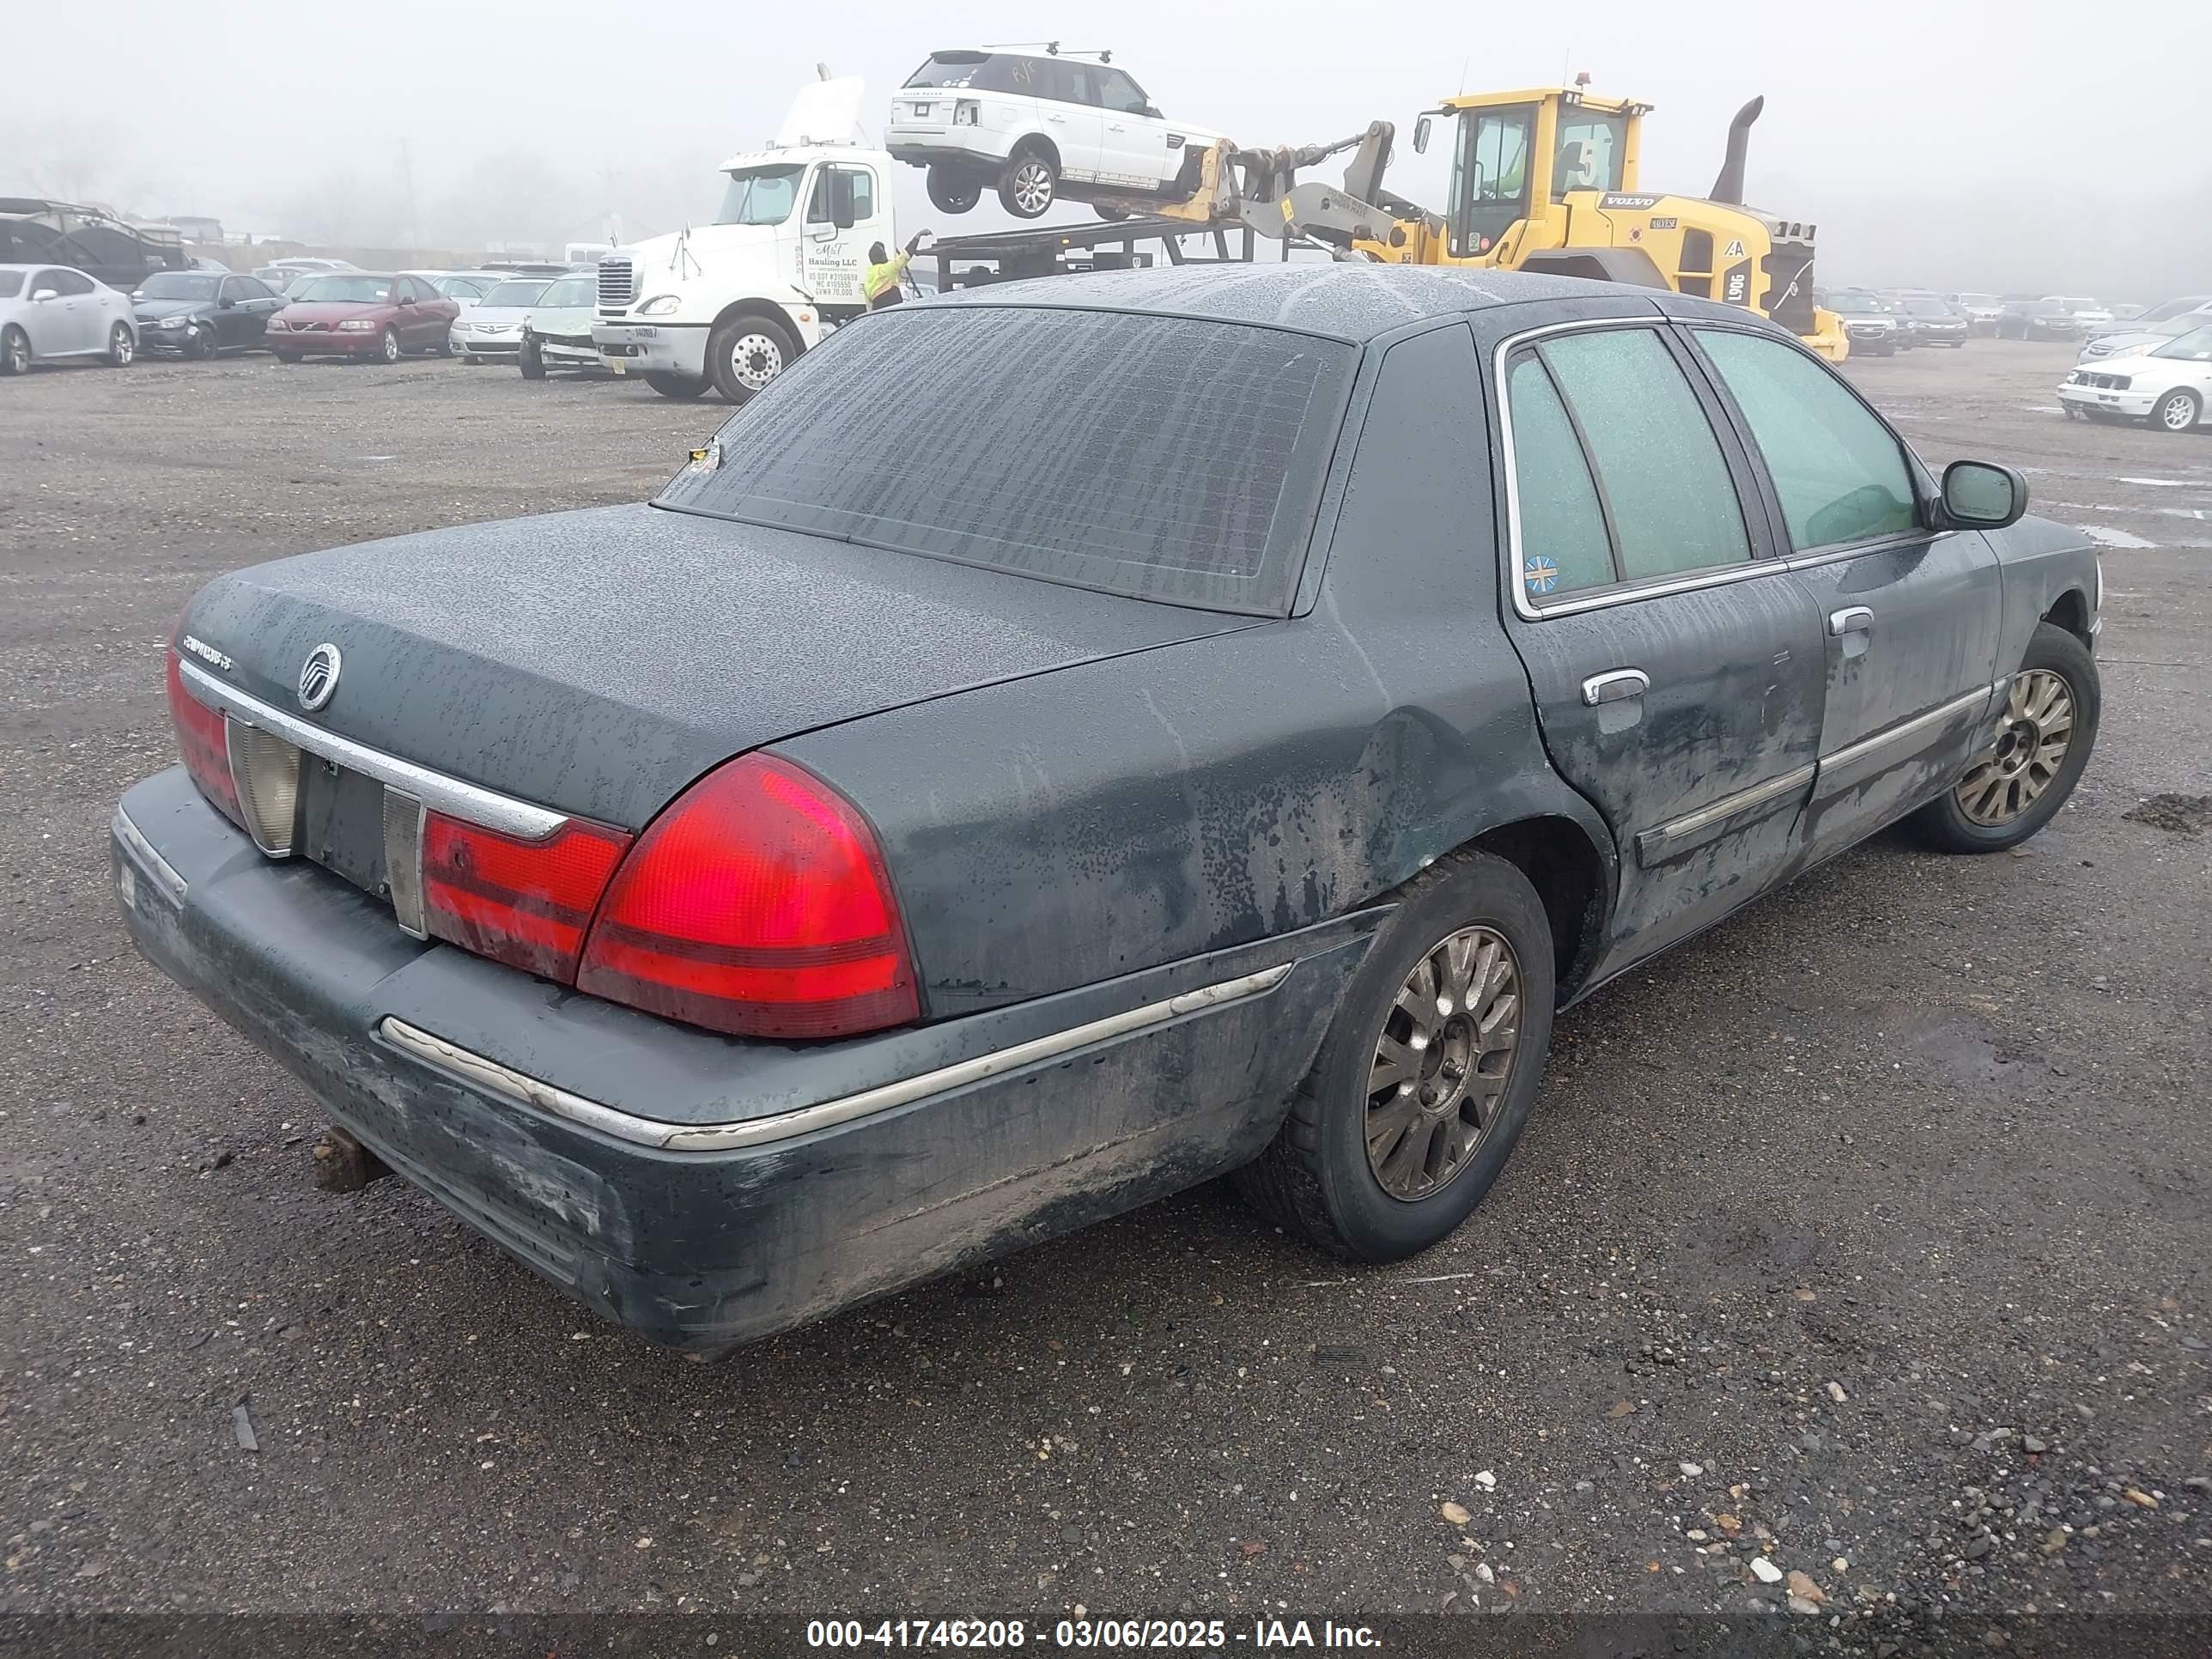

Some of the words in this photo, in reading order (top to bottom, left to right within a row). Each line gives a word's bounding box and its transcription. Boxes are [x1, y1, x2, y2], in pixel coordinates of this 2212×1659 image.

[1577, 139, 1597, 186] 5
[1607, 196, 1655, 206] VOLVO
[809, 258, 840, 267] Hauling
[1728, 274, 1746, 301] L90G
